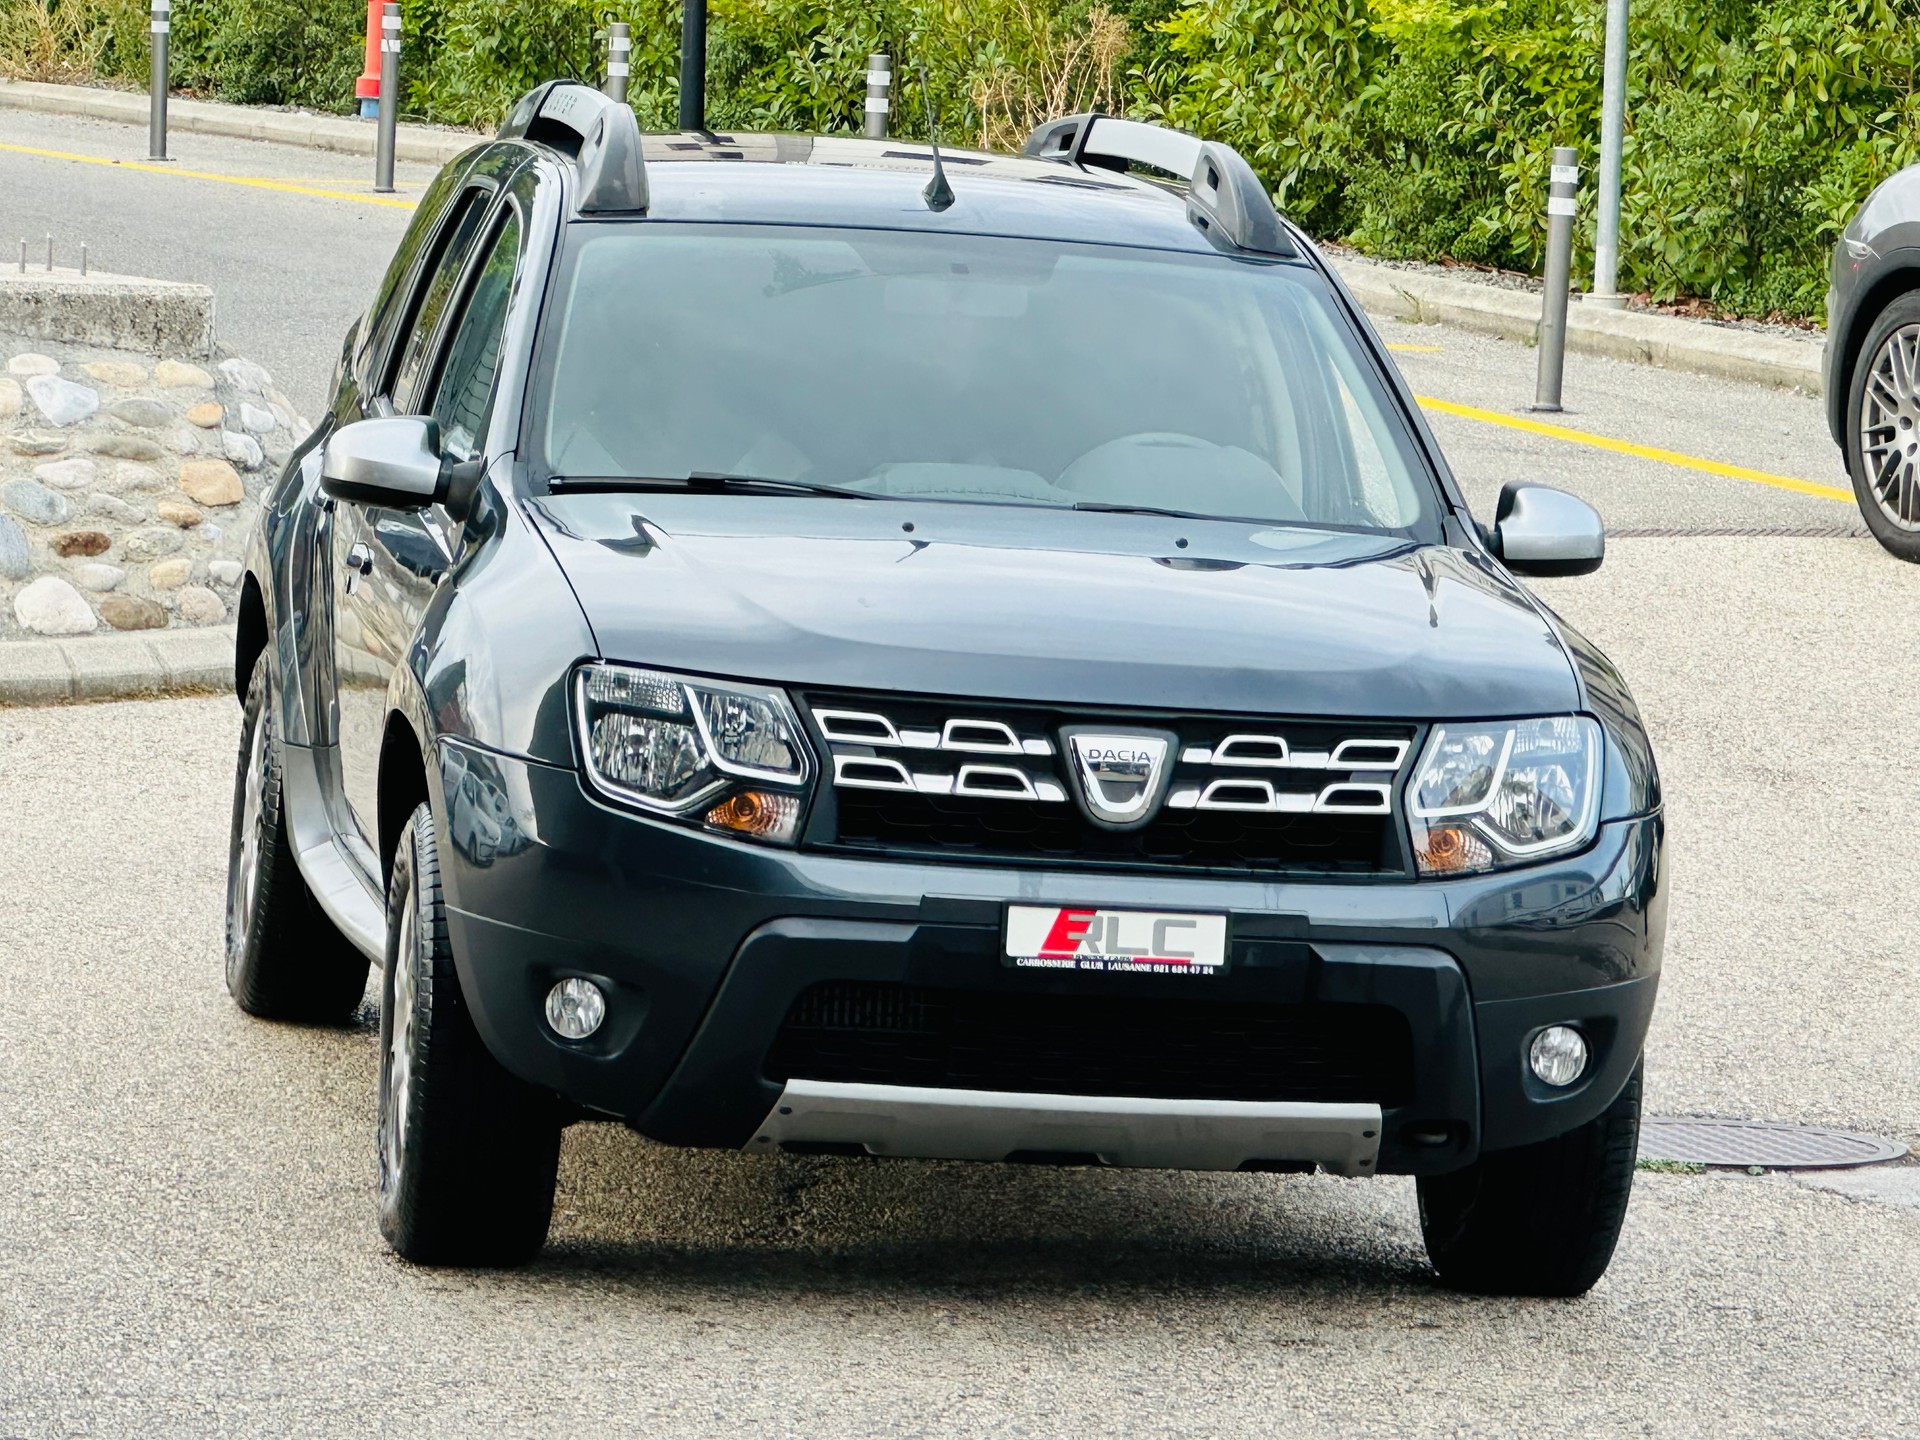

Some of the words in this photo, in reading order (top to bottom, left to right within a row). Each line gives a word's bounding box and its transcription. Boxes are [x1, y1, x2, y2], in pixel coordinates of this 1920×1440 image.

[1088, 748, 1151, 763] DACIA
[1016, 958, 1076, 969] CARROSSERIE
[1108, 962, 1152, 973] LAUSANNE
[1153, 964, 1169, 973] 021
[1190, 965, 1200, 975] 47
